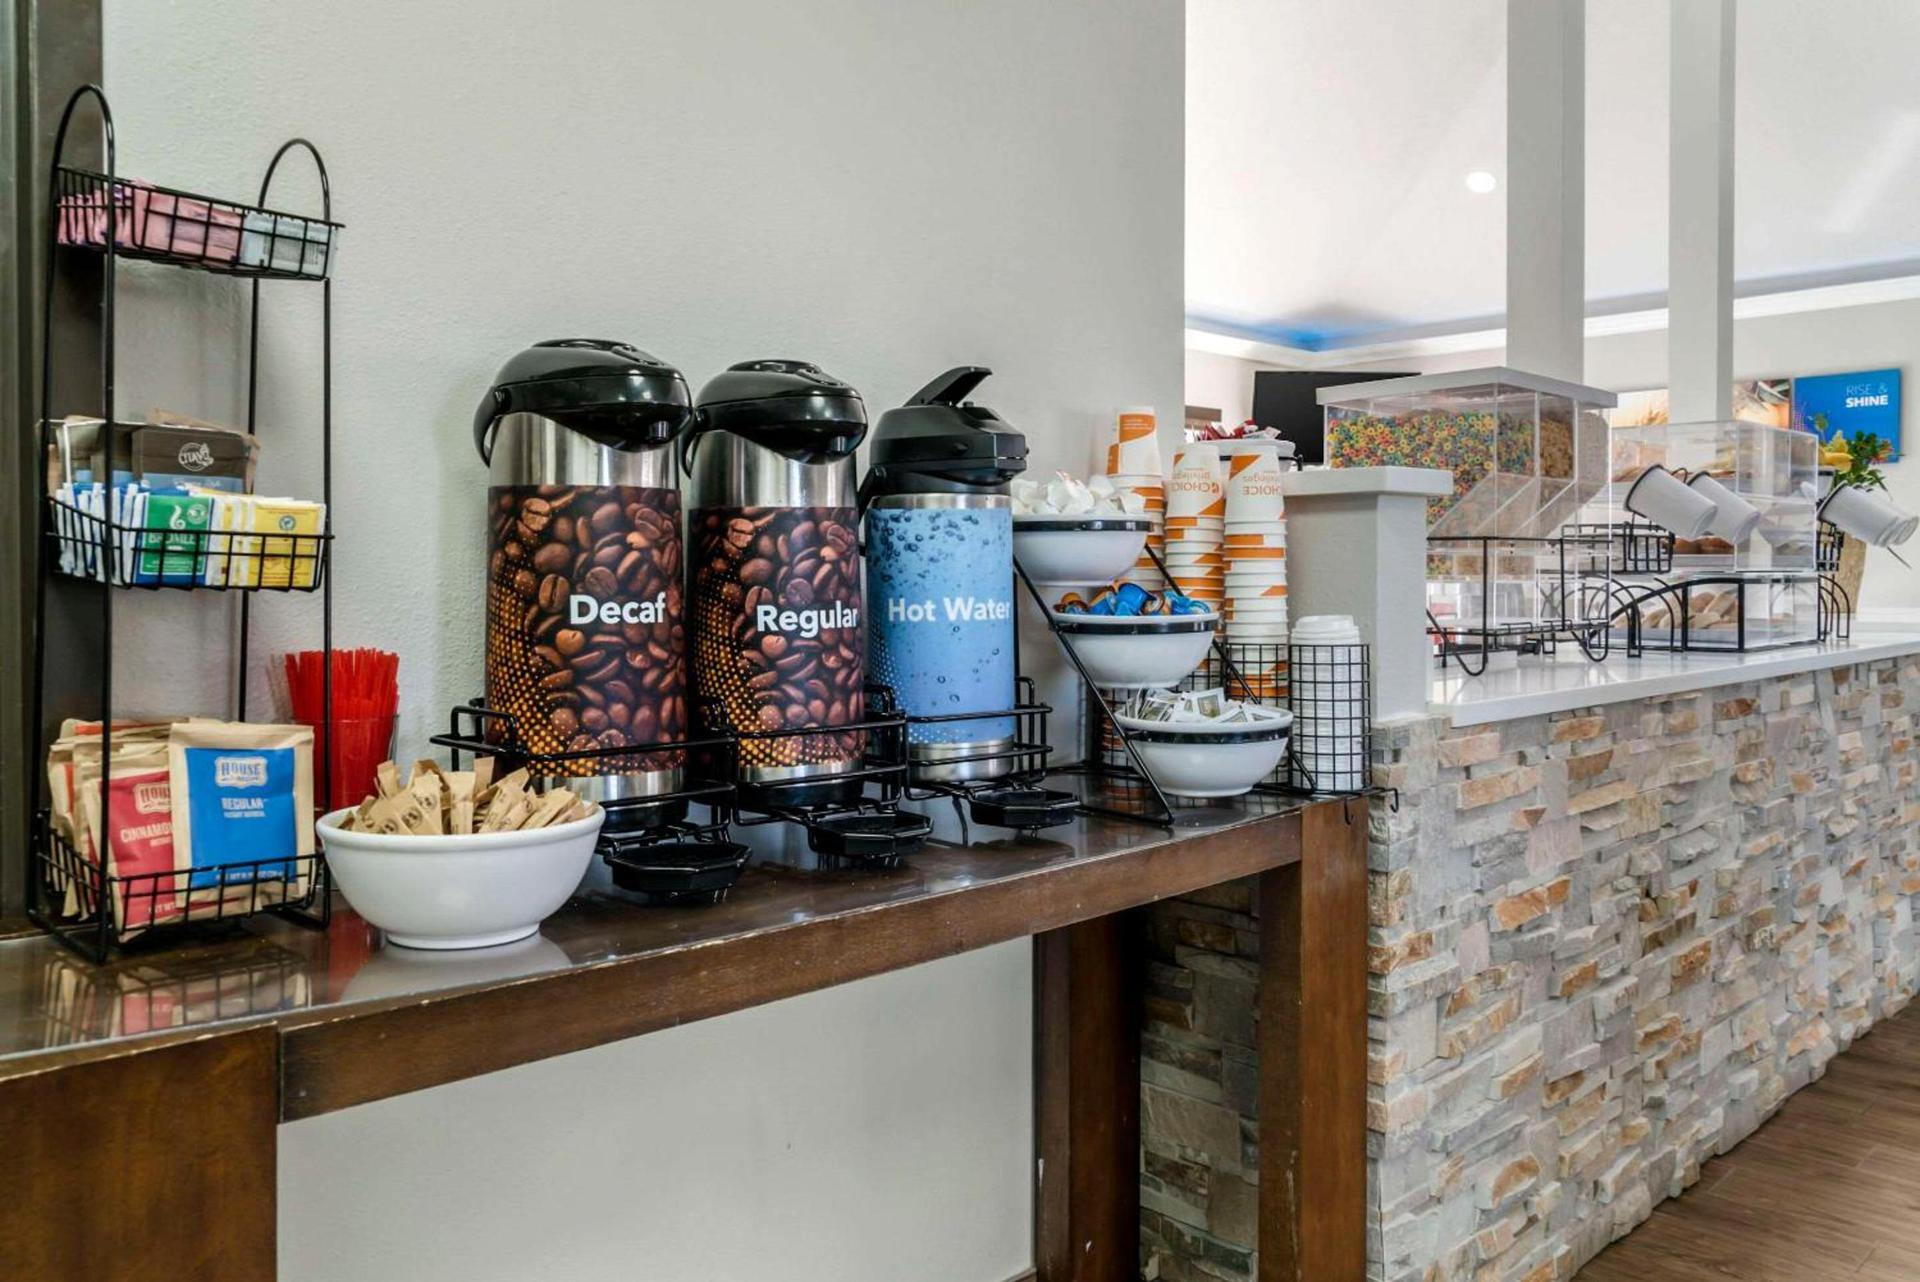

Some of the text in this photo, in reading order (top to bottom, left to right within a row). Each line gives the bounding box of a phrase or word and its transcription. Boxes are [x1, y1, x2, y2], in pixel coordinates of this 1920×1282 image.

[1846, 382, 1889, 395] RISE &
[1845, 394, 1888, 408] SHINE
[569, 591, 666, 625] Decaf
[888, 596, 1011, 621] Hot Water
[757, 600, 858, 638] Regular
[221, 762, 261, 777] HOUSE
[140, 786, 171, 803] HOU
[221, 797, 264, 810] REGULAR
[121, 822, 172, 843] CINNAMO
